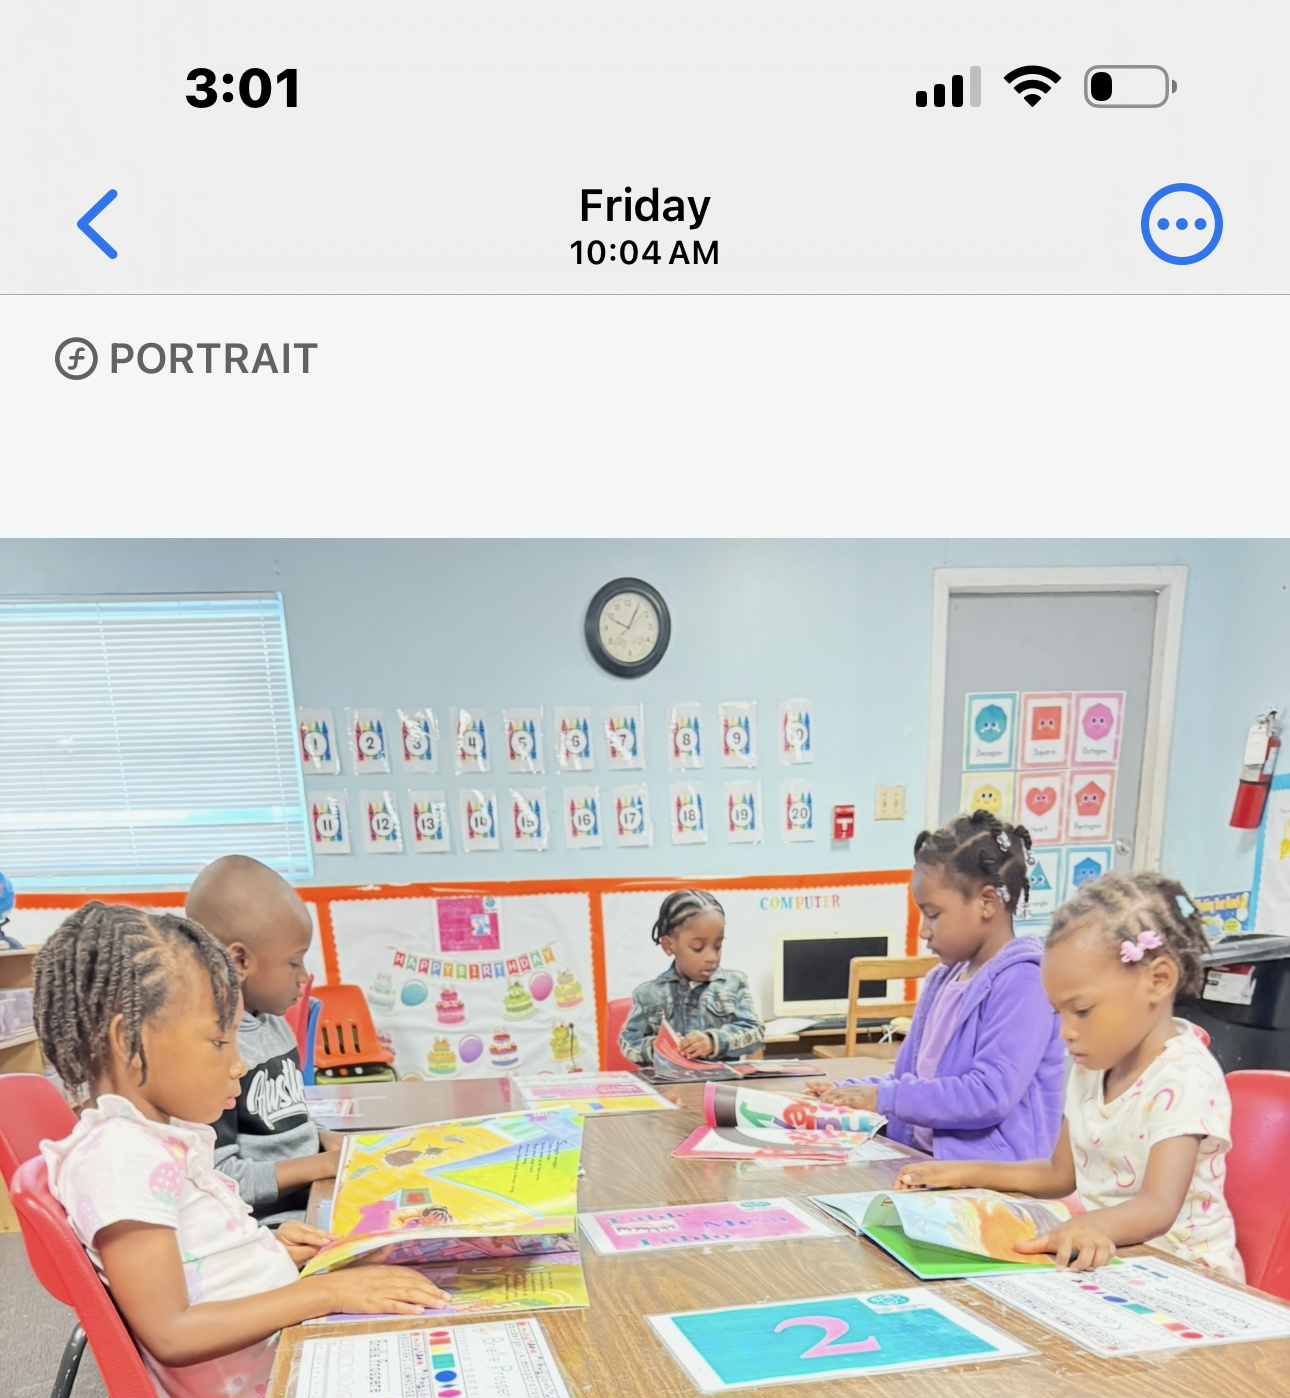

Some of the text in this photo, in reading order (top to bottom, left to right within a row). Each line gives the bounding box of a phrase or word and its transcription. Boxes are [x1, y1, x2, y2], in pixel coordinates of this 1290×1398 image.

[366, 737, 374, 749] 2
[469, 737, 476, 749] 4
[518, 737, 527, 750] 5
[571, 735, 580, 747] 6
[619, 734, 627, 746] 7
[682, 732, 690, 743] 8
[733, 732, 741, 744] 9
[624, 813, 636, 824] 17
[684, 809, 696, 821] 18
[736, 809, 748, 821] 19
[792, 808, 808, 819] 20
[323, 819, 332, 831] 11
[376, 818, 389, 830] 12
[421, 818, 434, 830] 13
[578, 814, 591, 826] 16
[760, 894, 841, 911] COMPUTER
[395, 948, 554, 977] HAPPY BIRTHDAY
[601, 1212, 692, 1225] Table
[703, 1215, 788, 1228] Mesa
[774, 1315, 881, 1359] 2
